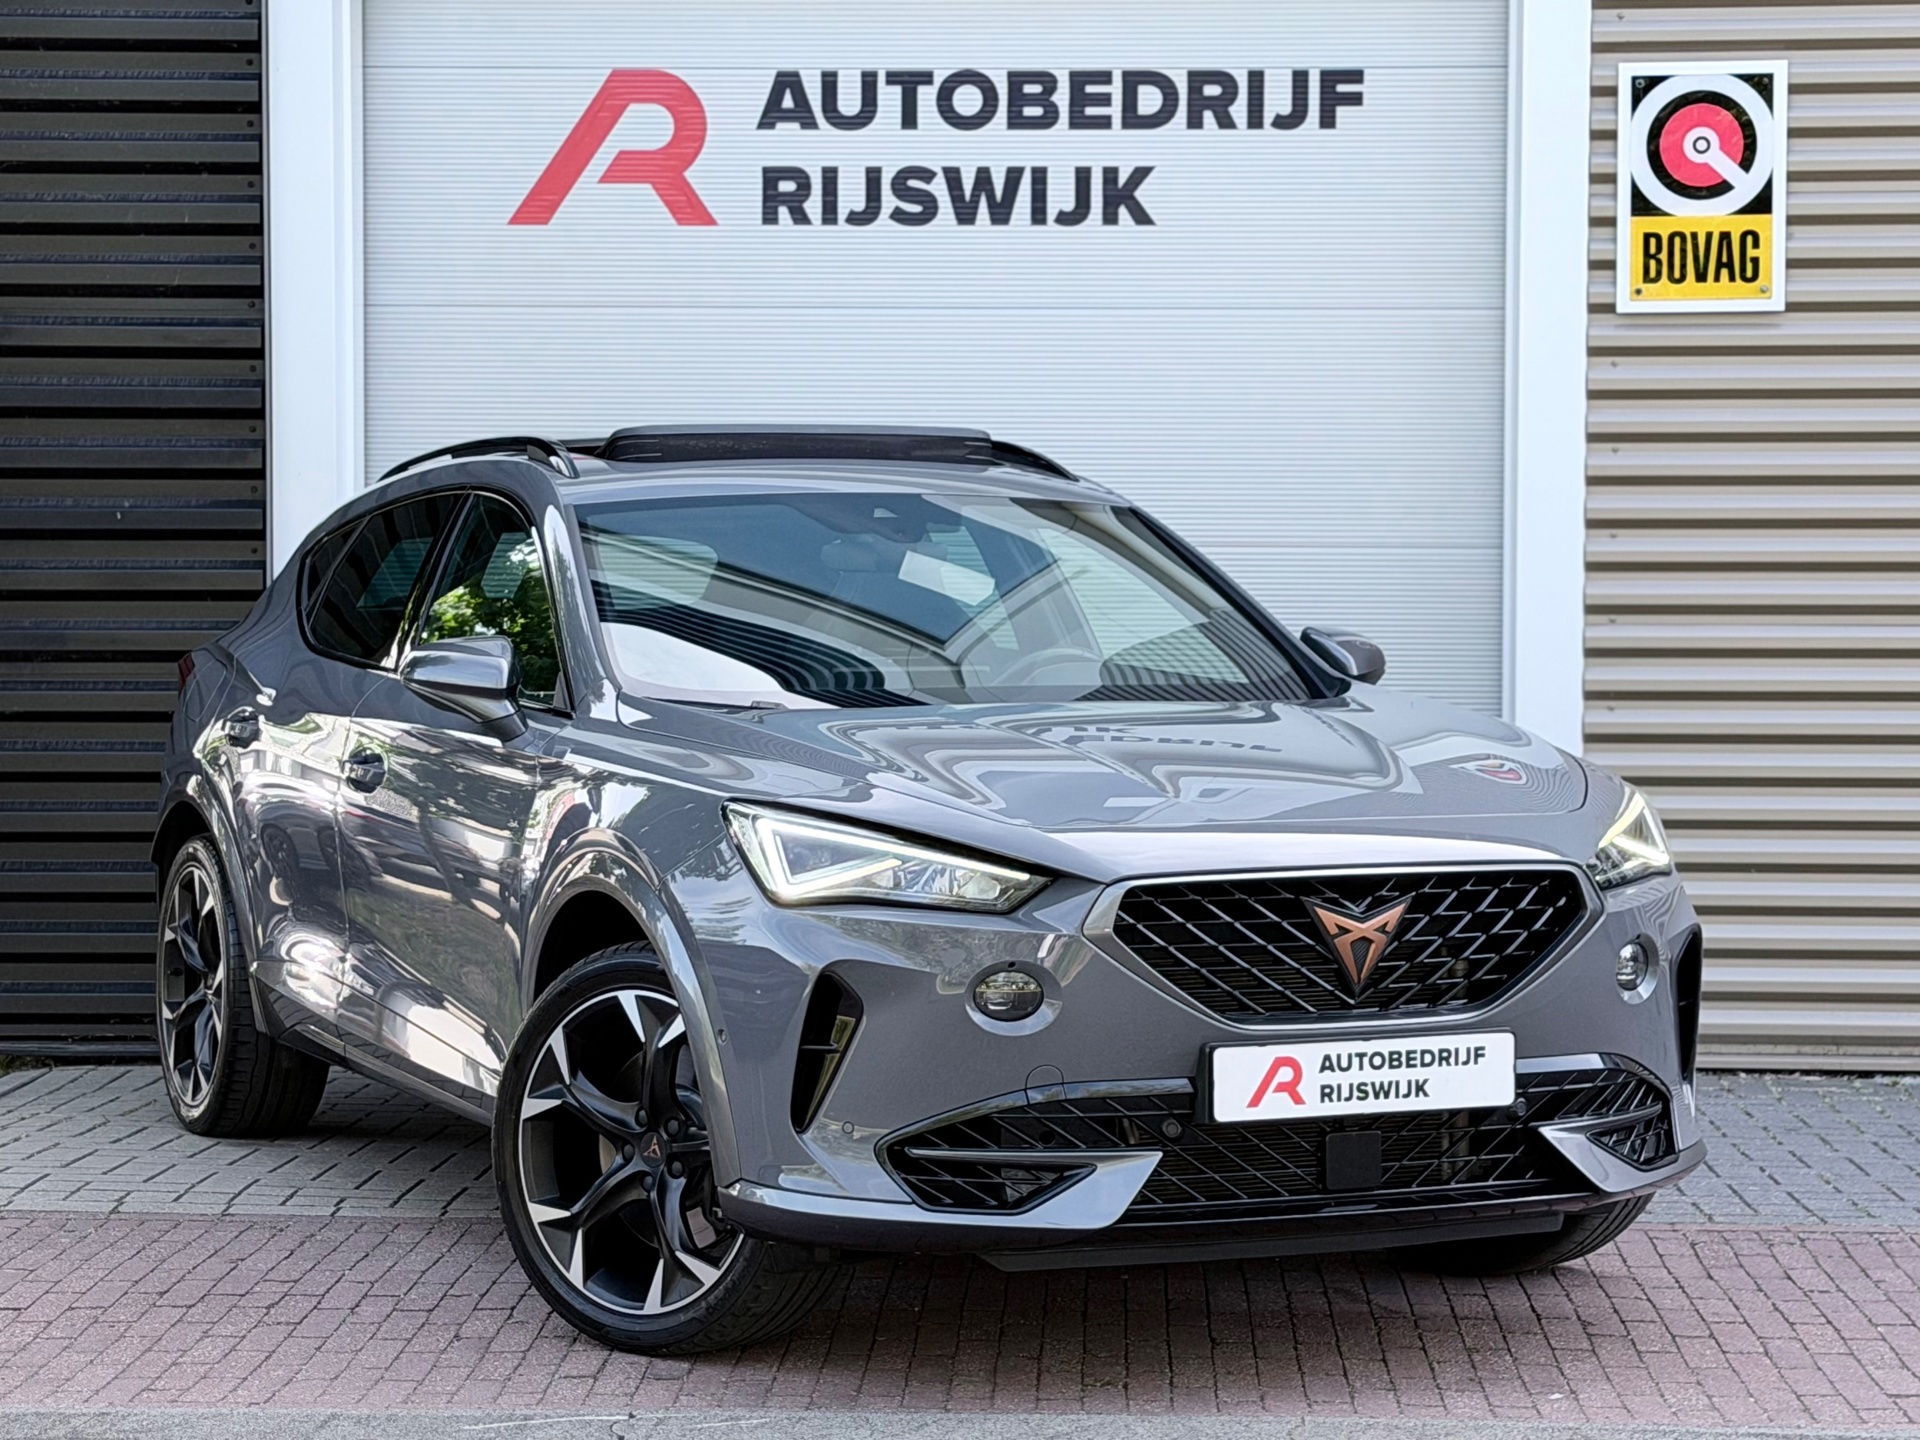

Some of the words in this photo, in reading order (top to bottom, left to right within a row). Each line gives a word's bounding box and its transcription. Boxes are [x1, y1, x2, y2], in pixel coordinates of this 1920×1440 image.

[757, 69, 1364, 130] AUTOBEDRIJF
[762, 166, 1156, 226] RIJSWIJK
[1643, 230, 1760, 284] BOVAG
[1319, 1046, 1486, 1073] AUTOBEDRIJF
[1320, 1079, 1430, 1103] RIJSWIJK
